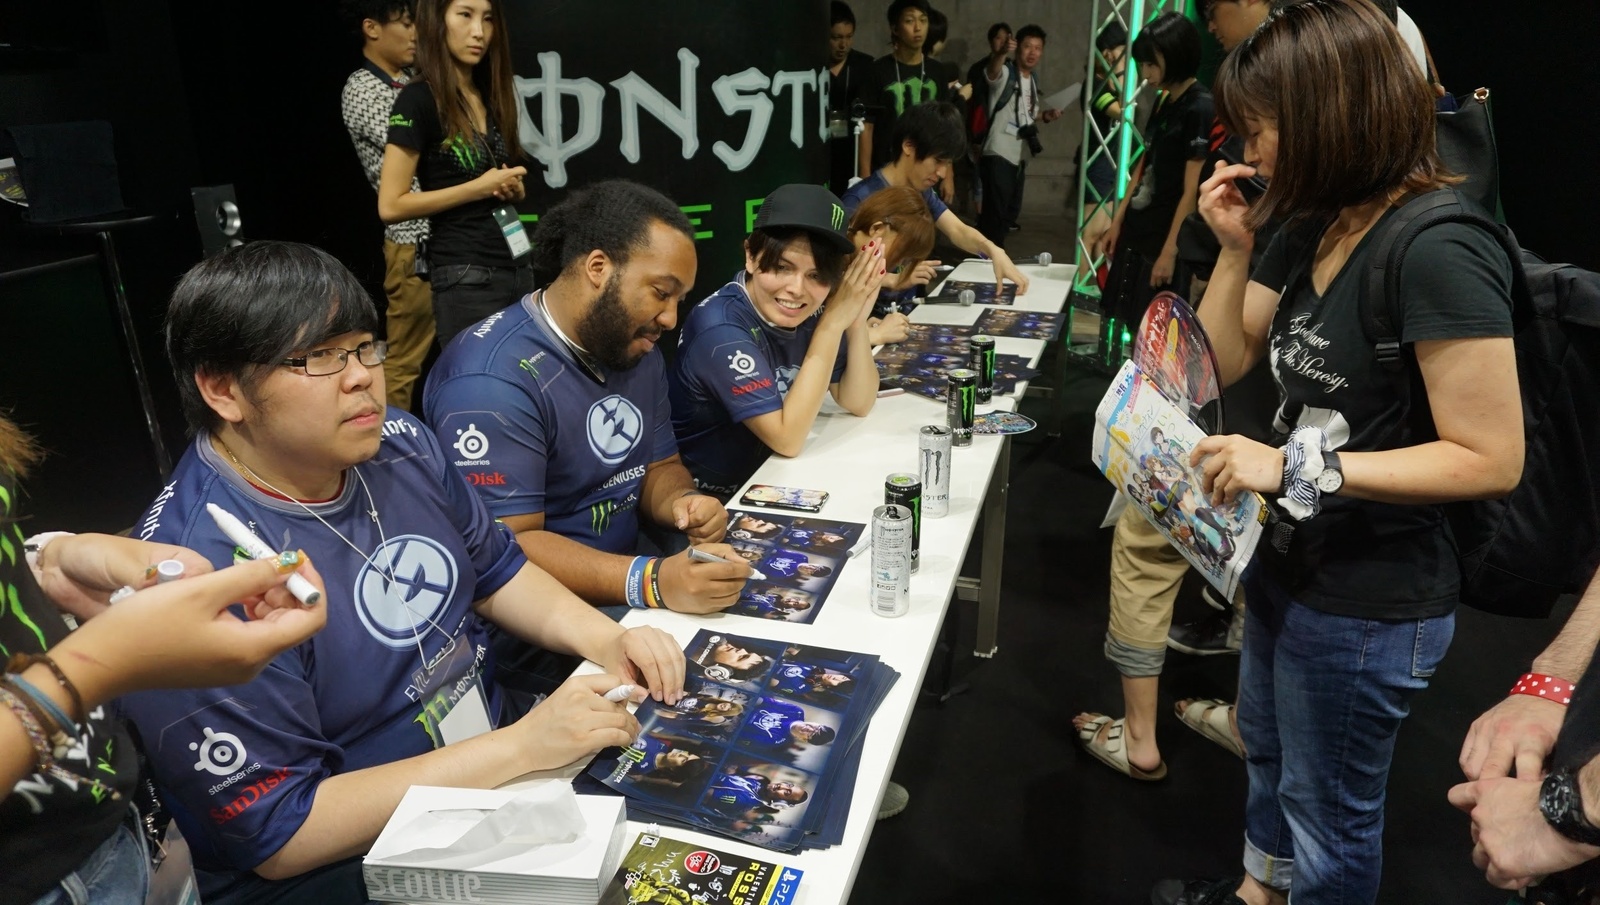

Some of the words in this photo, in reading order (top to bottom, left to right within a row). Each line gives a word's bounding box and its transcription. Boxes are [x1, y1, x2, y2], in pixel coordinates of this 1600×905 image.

[512, 47, 830, 188] ONSTE
[466, 471, 507, 487] Disk
[208, 761, 262, 796] steelseries
[210, 765, 295, 825] SanDisk
